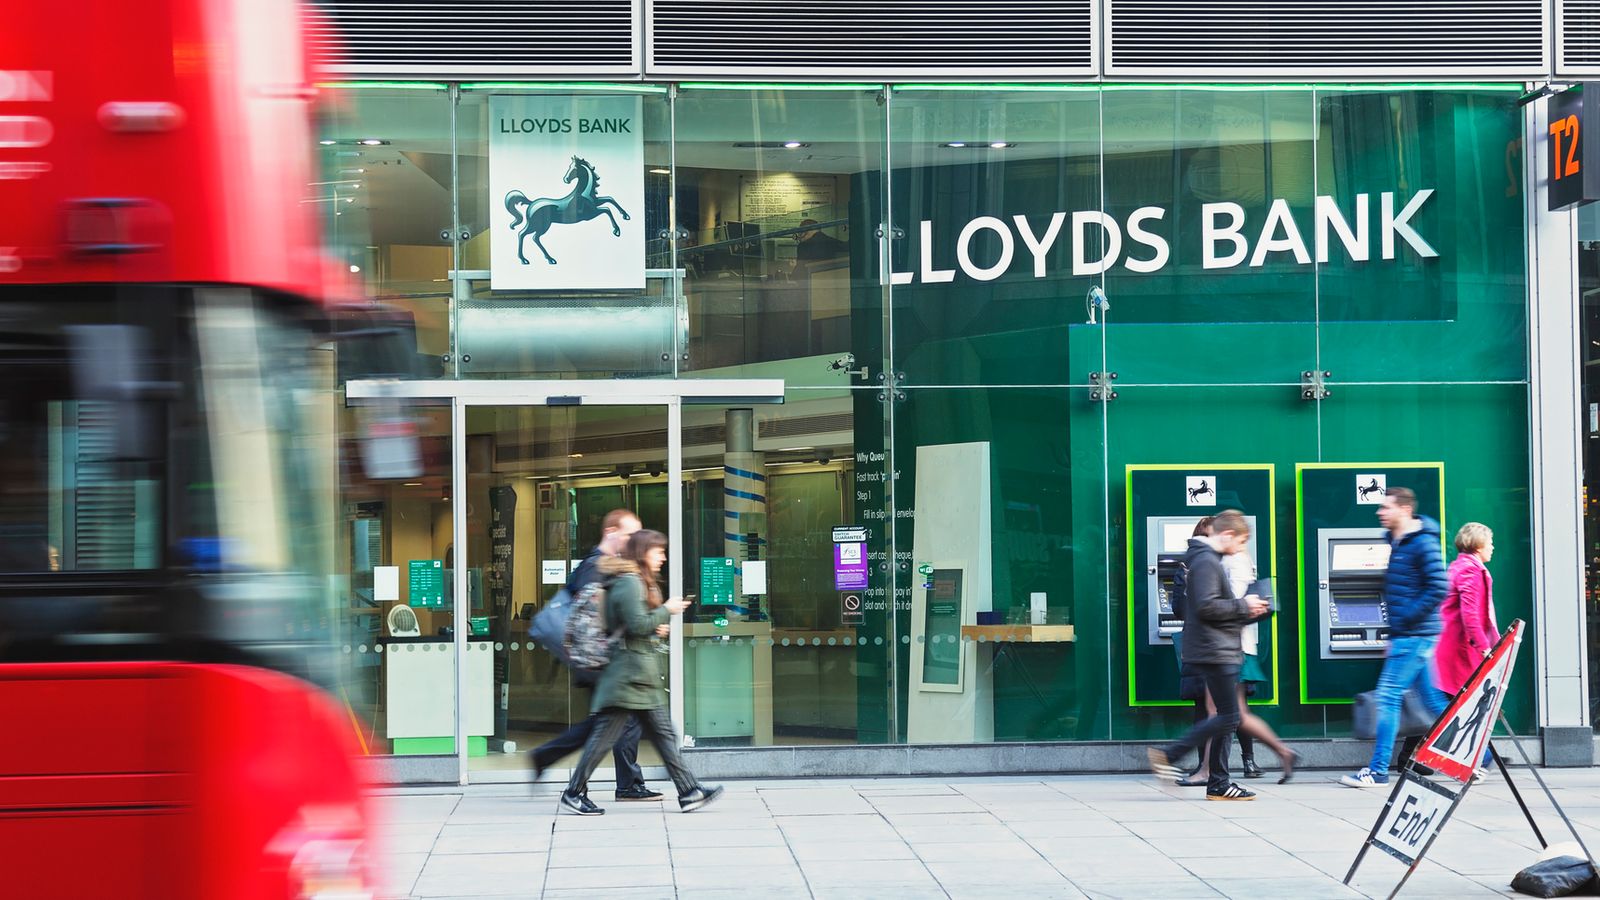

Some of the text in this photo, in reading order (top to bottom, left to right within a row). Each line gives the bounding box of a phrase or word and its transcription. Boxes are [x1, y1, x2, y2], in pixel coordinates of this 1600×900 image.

[500, 118, 631, 133] LLOYDS BANK
[1549, 114, 1580, 181] T2
[879, 188, 1440, 286] LLOYDS BANK
[856, 452, 885, 464] Why Queu
[856, 472, 867, 482] Fast
[867, 471, 880, 481] track
[857, 490, 871, 502] Step 1
[871, 509, 876, 519] in
[877, 508, 886, 520] slip
[869, 529, 872, 538] 2
[878, 551, 887, 560] cas
[895, 550, 913, 562] heque,
[869, 568, 872, 576] 3
[875, 587, 885, 596] into
[864, 600, 874, 610] slot
[874, 600, 885, 610] and
[1388, 794, 1438, 848] End
